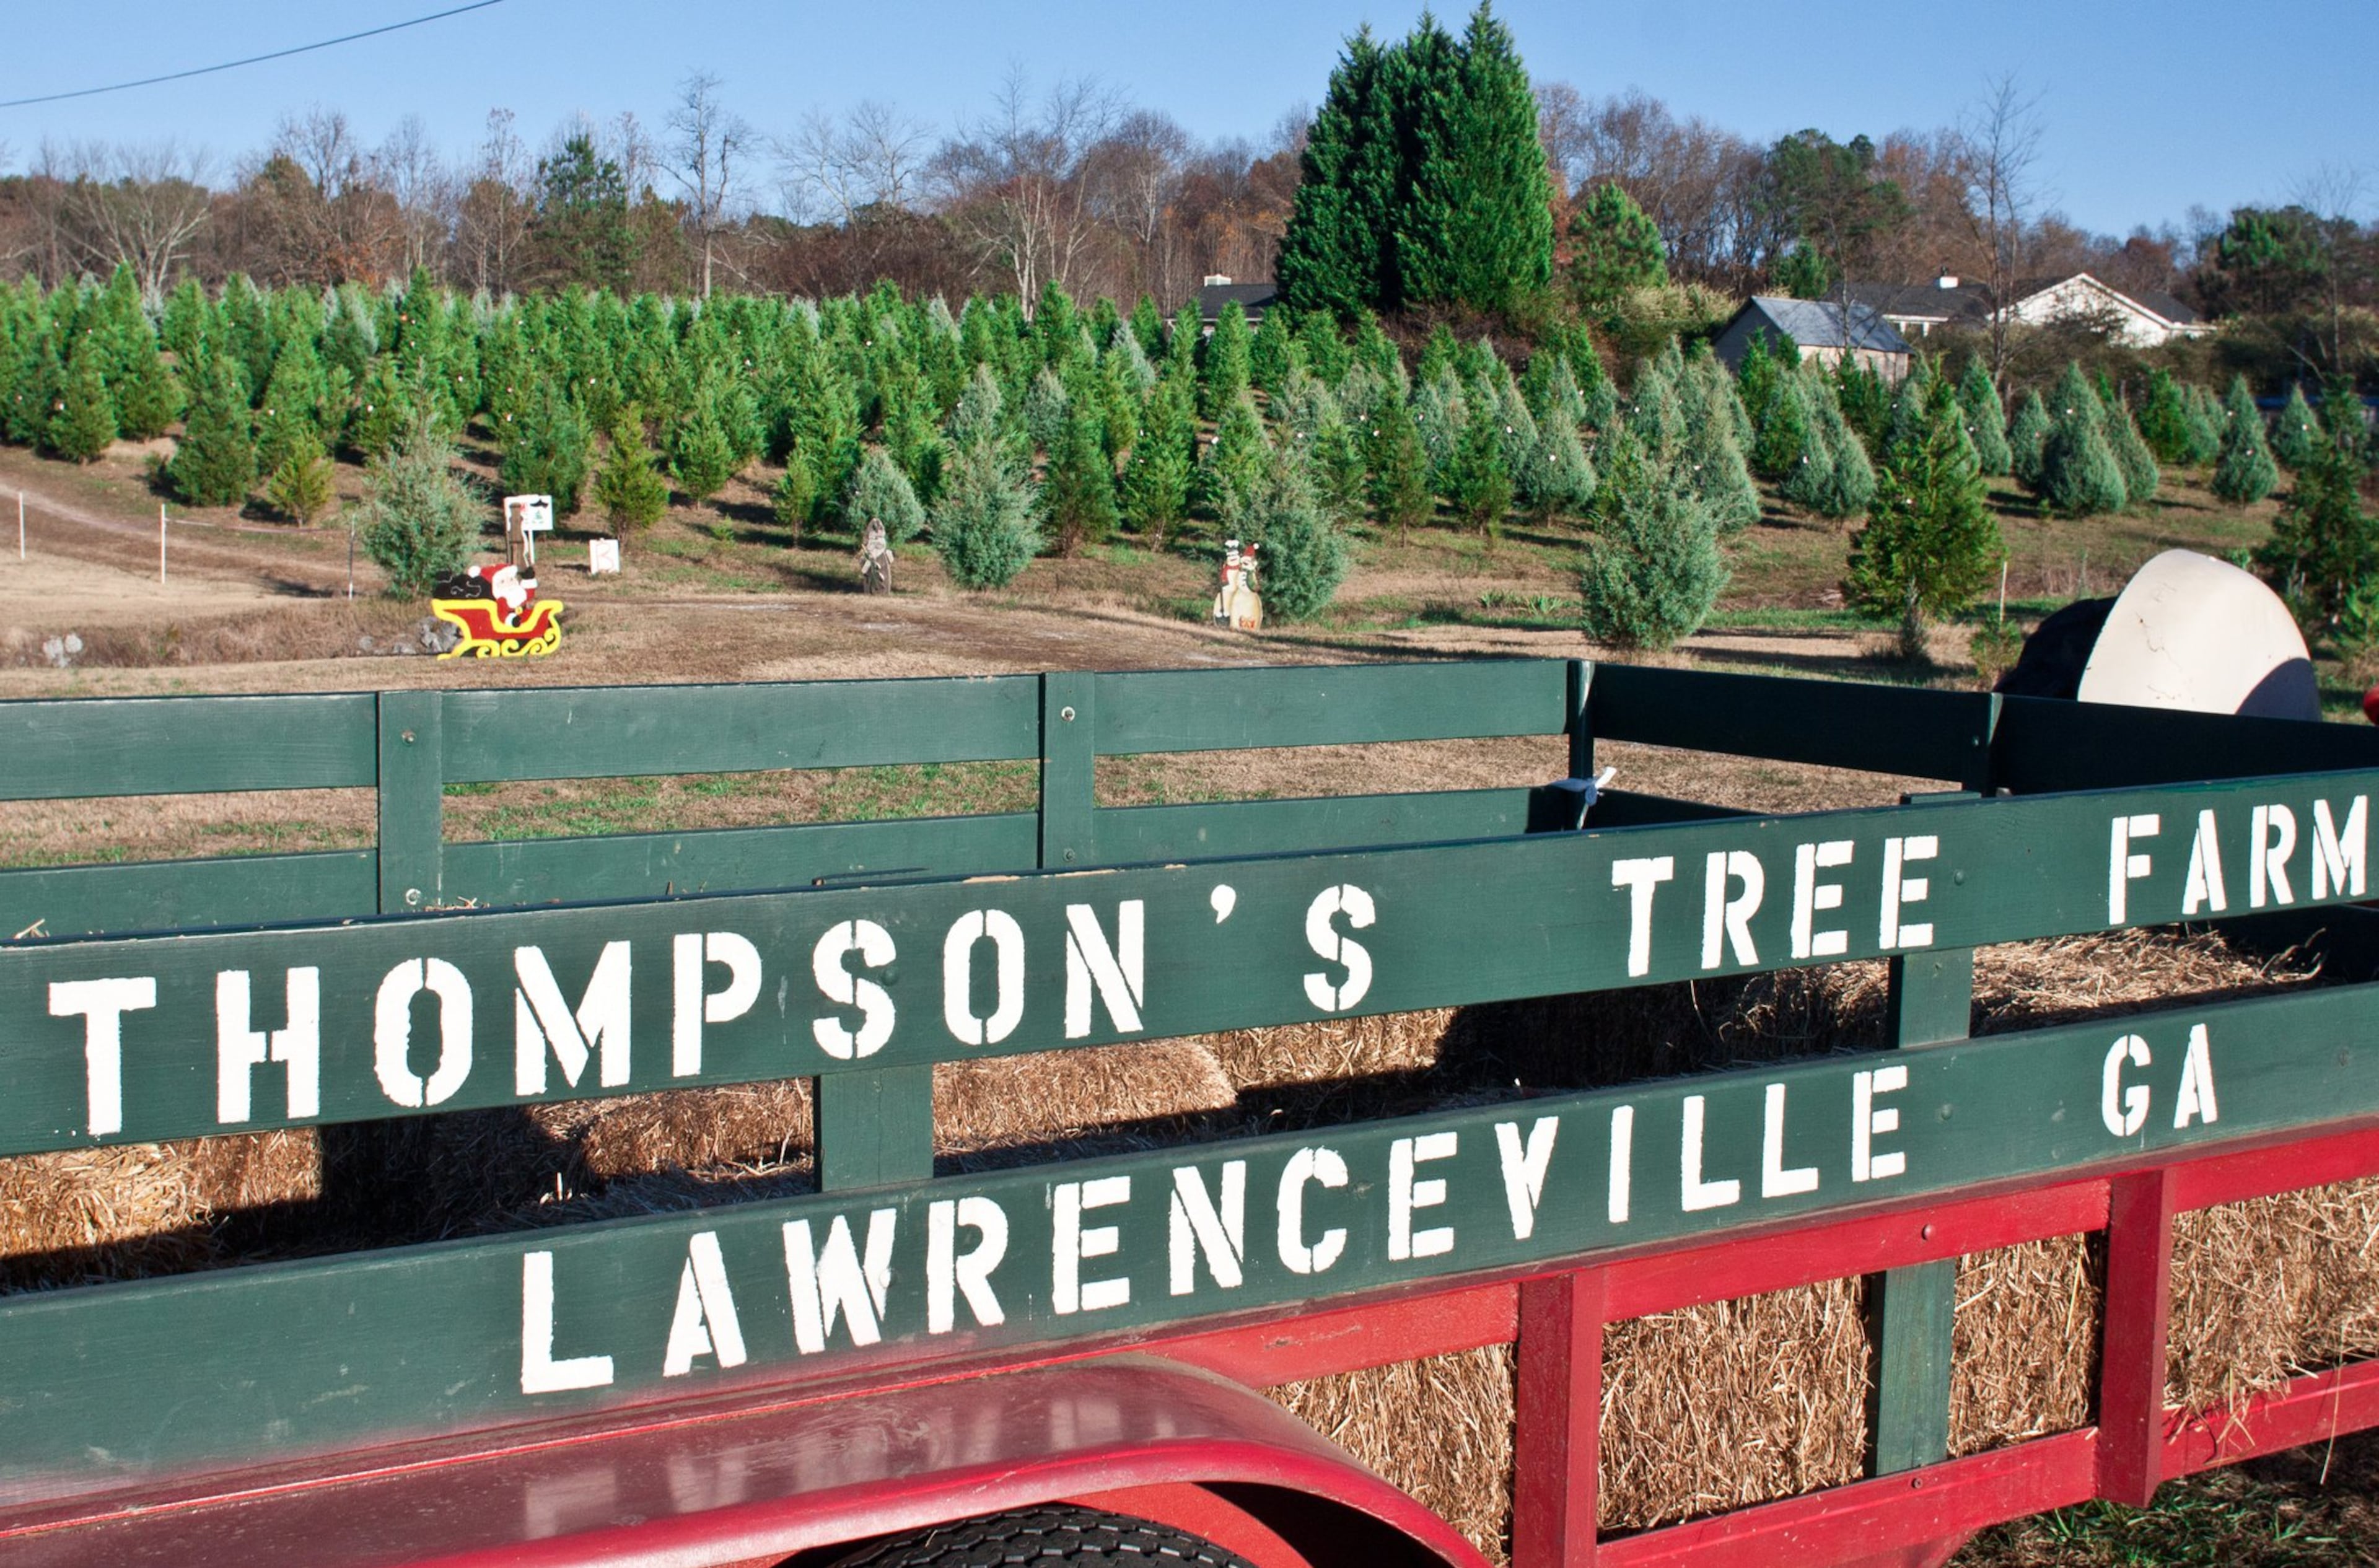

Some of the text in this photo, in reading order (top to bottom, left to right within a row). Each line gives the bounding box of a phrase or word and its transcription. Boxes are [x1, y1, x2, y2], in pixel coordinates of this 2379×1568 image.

[50, 795, 2367, 1136] THOMPSON'S TREE FARM
[521, 1024, 2217, 1393] LAWRENCEVILLE GA
